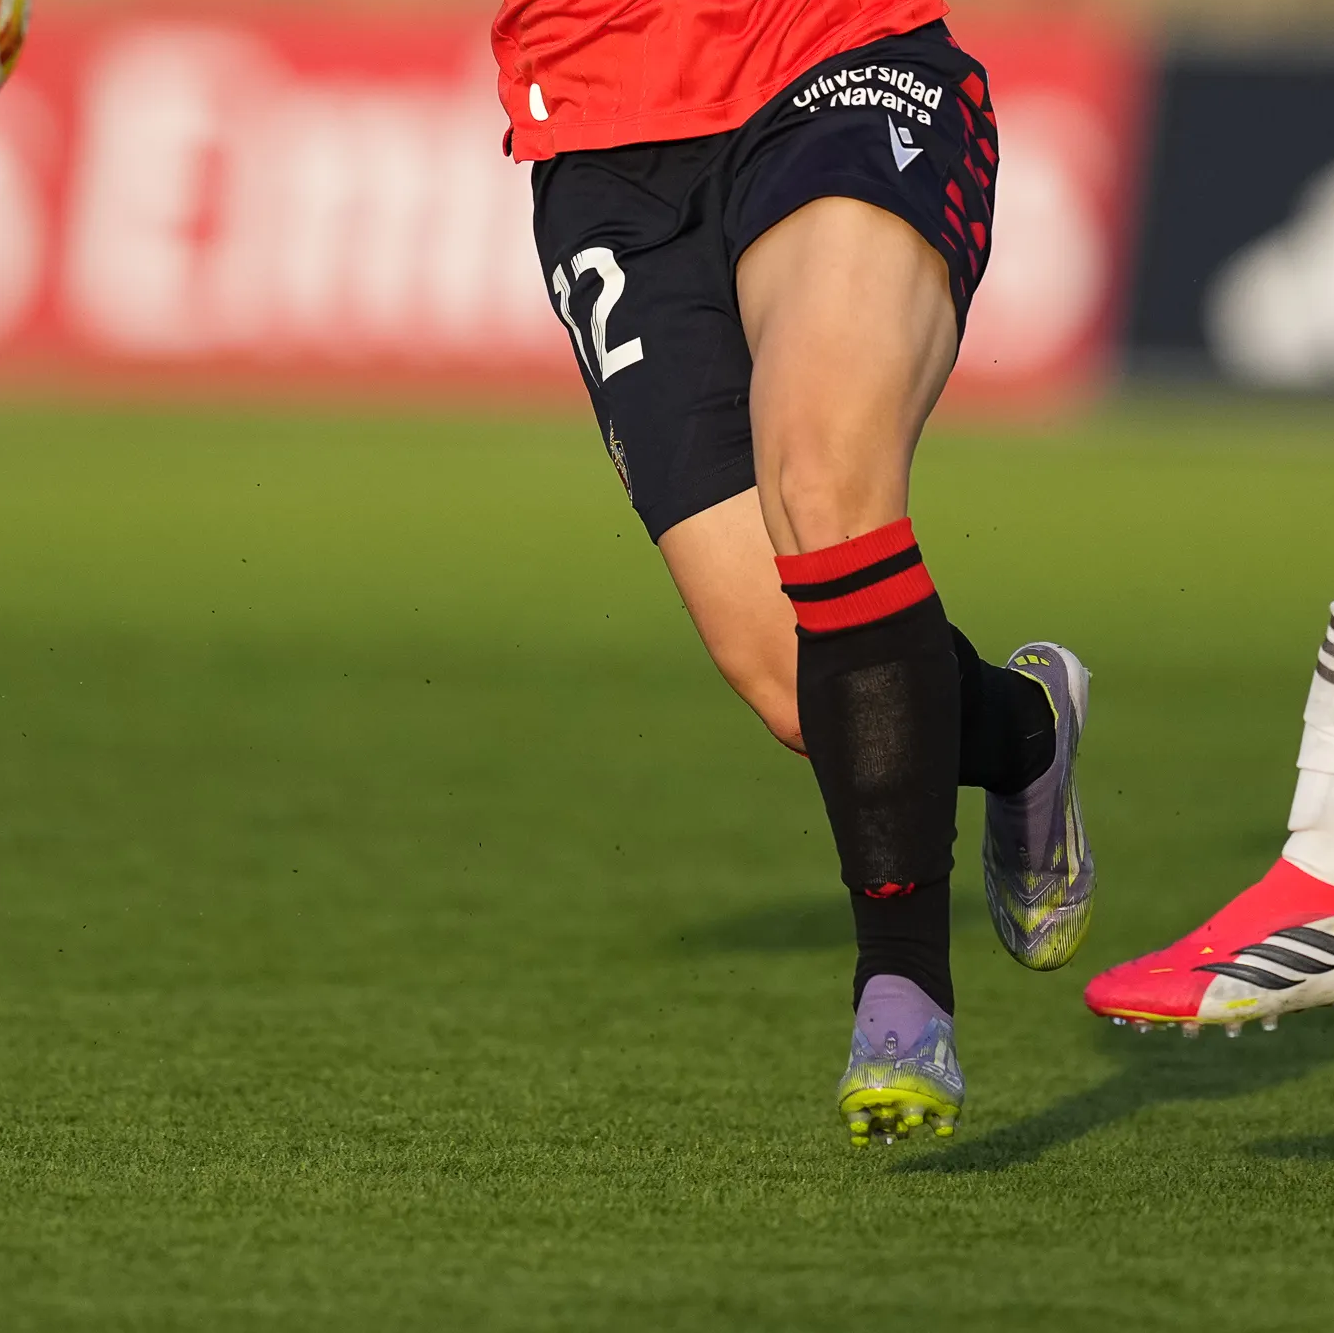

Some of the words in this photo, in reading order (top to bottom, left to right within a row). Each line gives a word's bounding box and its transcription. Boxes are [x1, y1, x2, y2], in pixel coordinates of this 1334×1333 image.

[792, 65, 943, 110] Universidad
[830, 87, 932, 126] Navarra
[552, 246, 644, 388] 12
